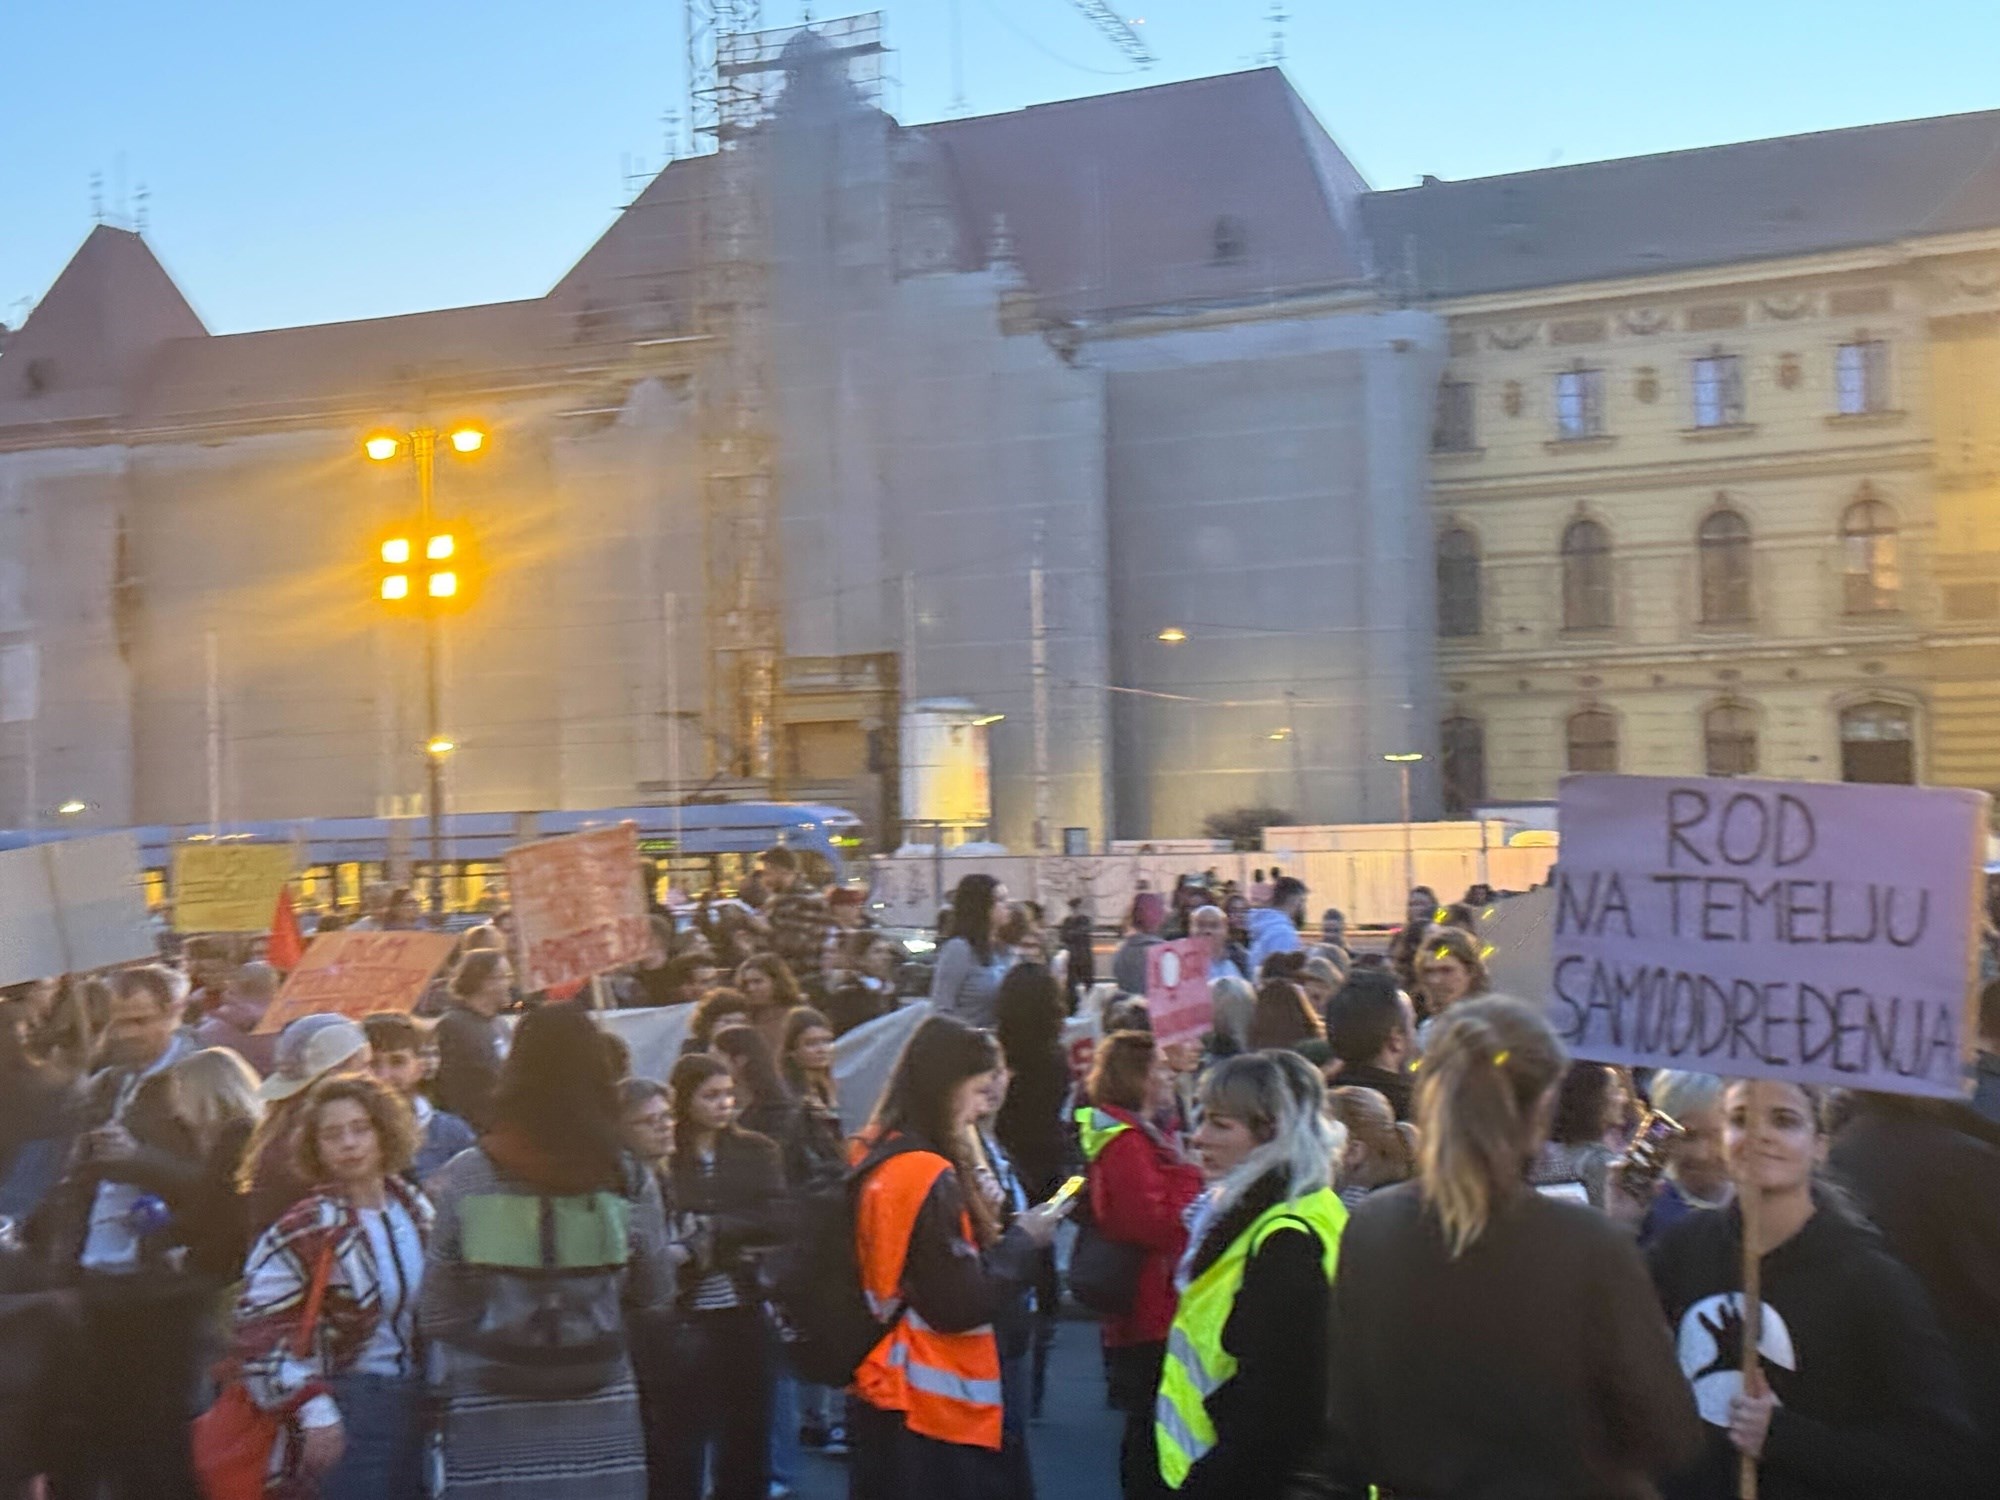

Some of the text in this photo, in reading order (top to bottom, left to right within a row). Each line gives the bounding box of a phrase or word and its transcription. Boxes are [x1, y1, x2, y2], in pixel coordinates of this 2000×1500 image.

[1666, 788, 1816, 869] ROD
[1555, 871, 1930, 948] NA TEMELJU
[1553, 954, 1955, 1077] SAMOODREĐENJA
